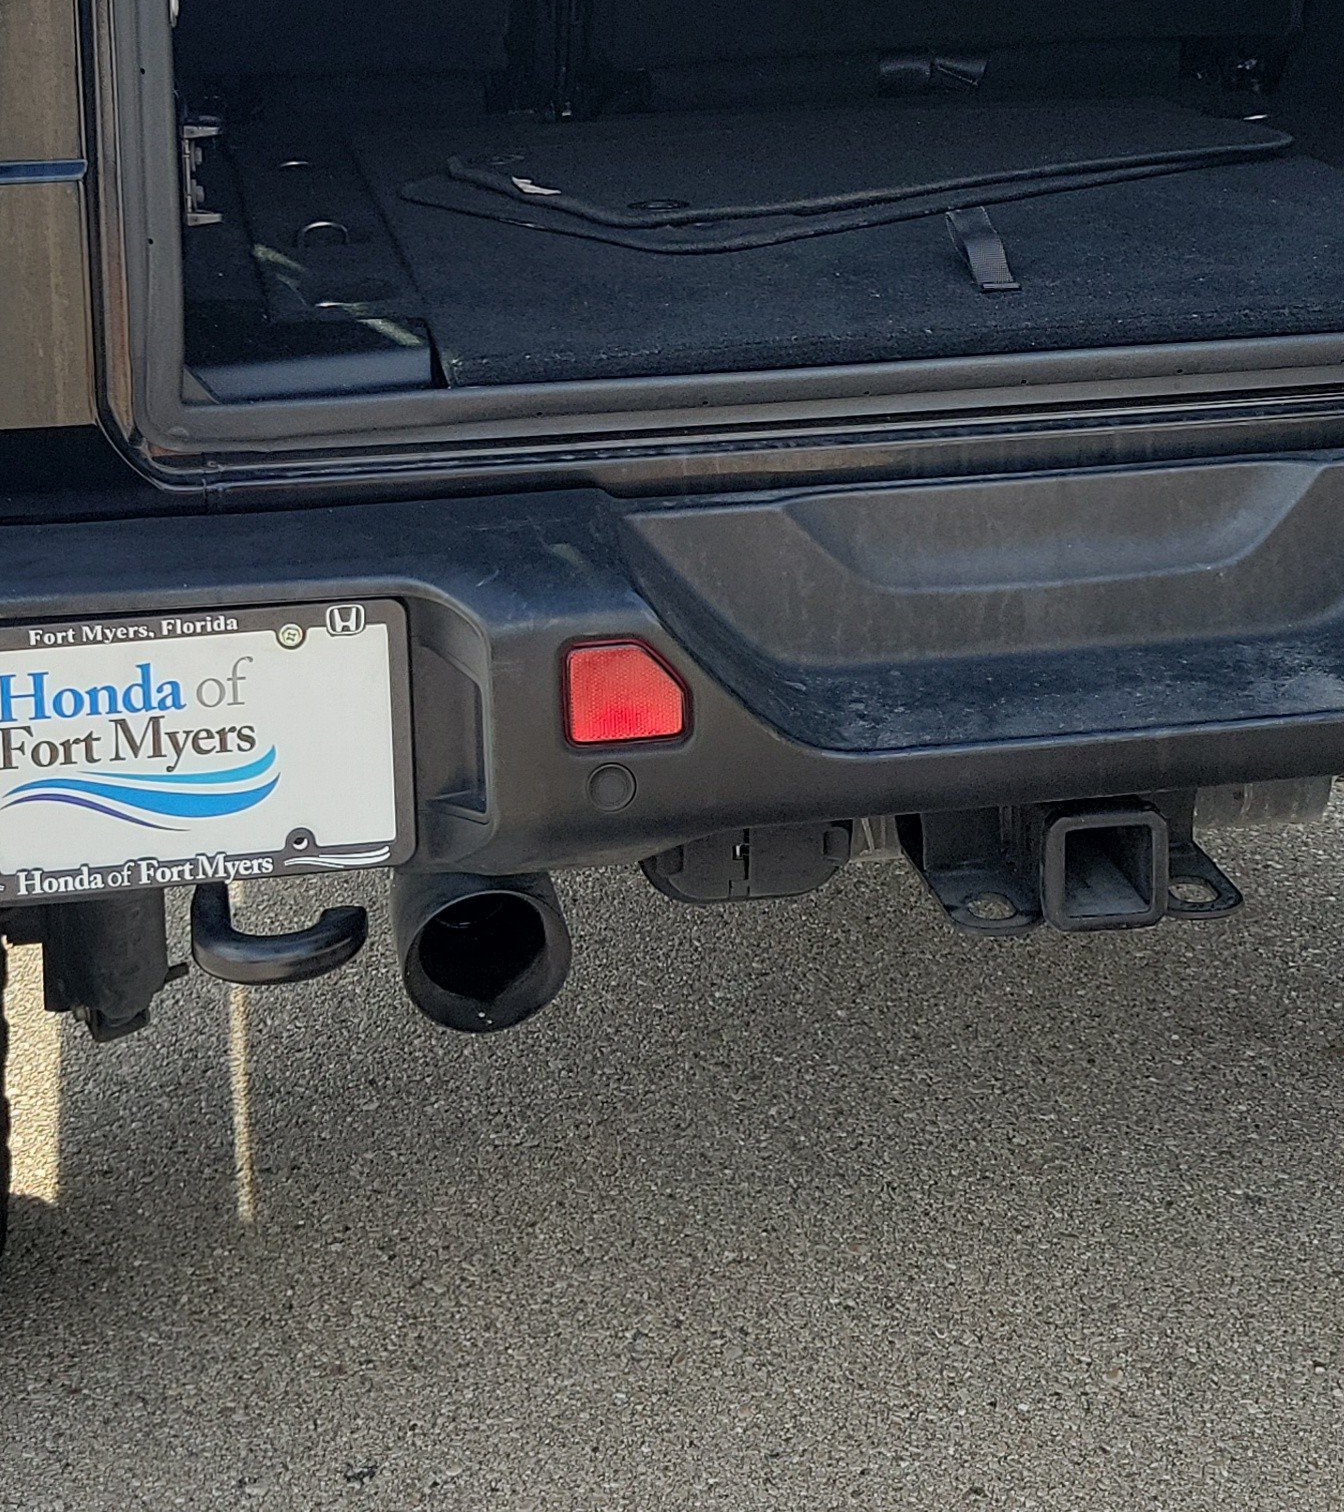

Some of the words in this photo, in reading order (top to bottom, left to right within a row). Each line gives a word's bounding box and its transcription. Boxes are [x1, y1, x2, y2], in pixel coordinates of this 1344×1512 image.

[28, 628, 75, 646] Fort
[81, 624, 155, 645] Myers,
[161, 615, 239, 636] Florida
[196, 655, 254, 708] of
[109, 715, 257, 773] Myers
[16, 863, 105, 896] Honda
[107, 861, 135, 888] of
[137, 858, 195, 885] Fort
[195, 853, 274, 881] Myers
